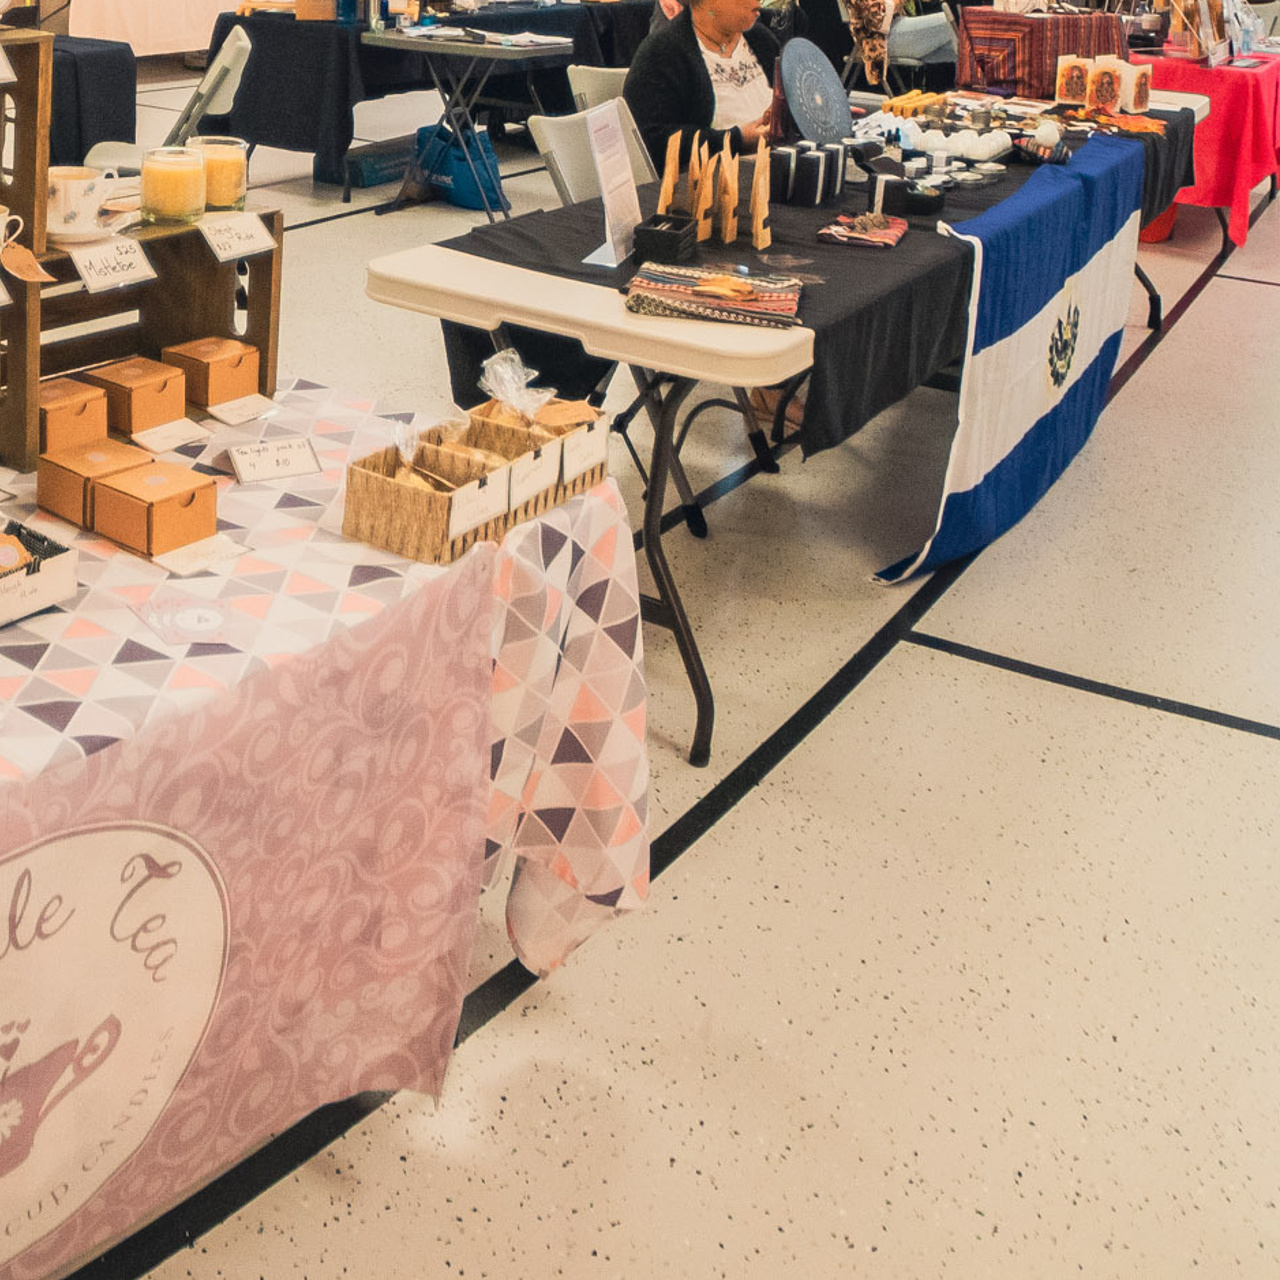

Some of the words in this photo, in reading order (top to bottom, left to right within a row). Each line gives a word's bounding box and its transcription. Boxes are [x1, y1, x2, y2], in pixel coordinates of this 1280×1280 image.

[83, 258, 137, 278] Mistletoe
[116, 245, 137, 256] $25
[108, 851, 183, 984] Tea
[80, 1025, 176, 1174] CANDLES
